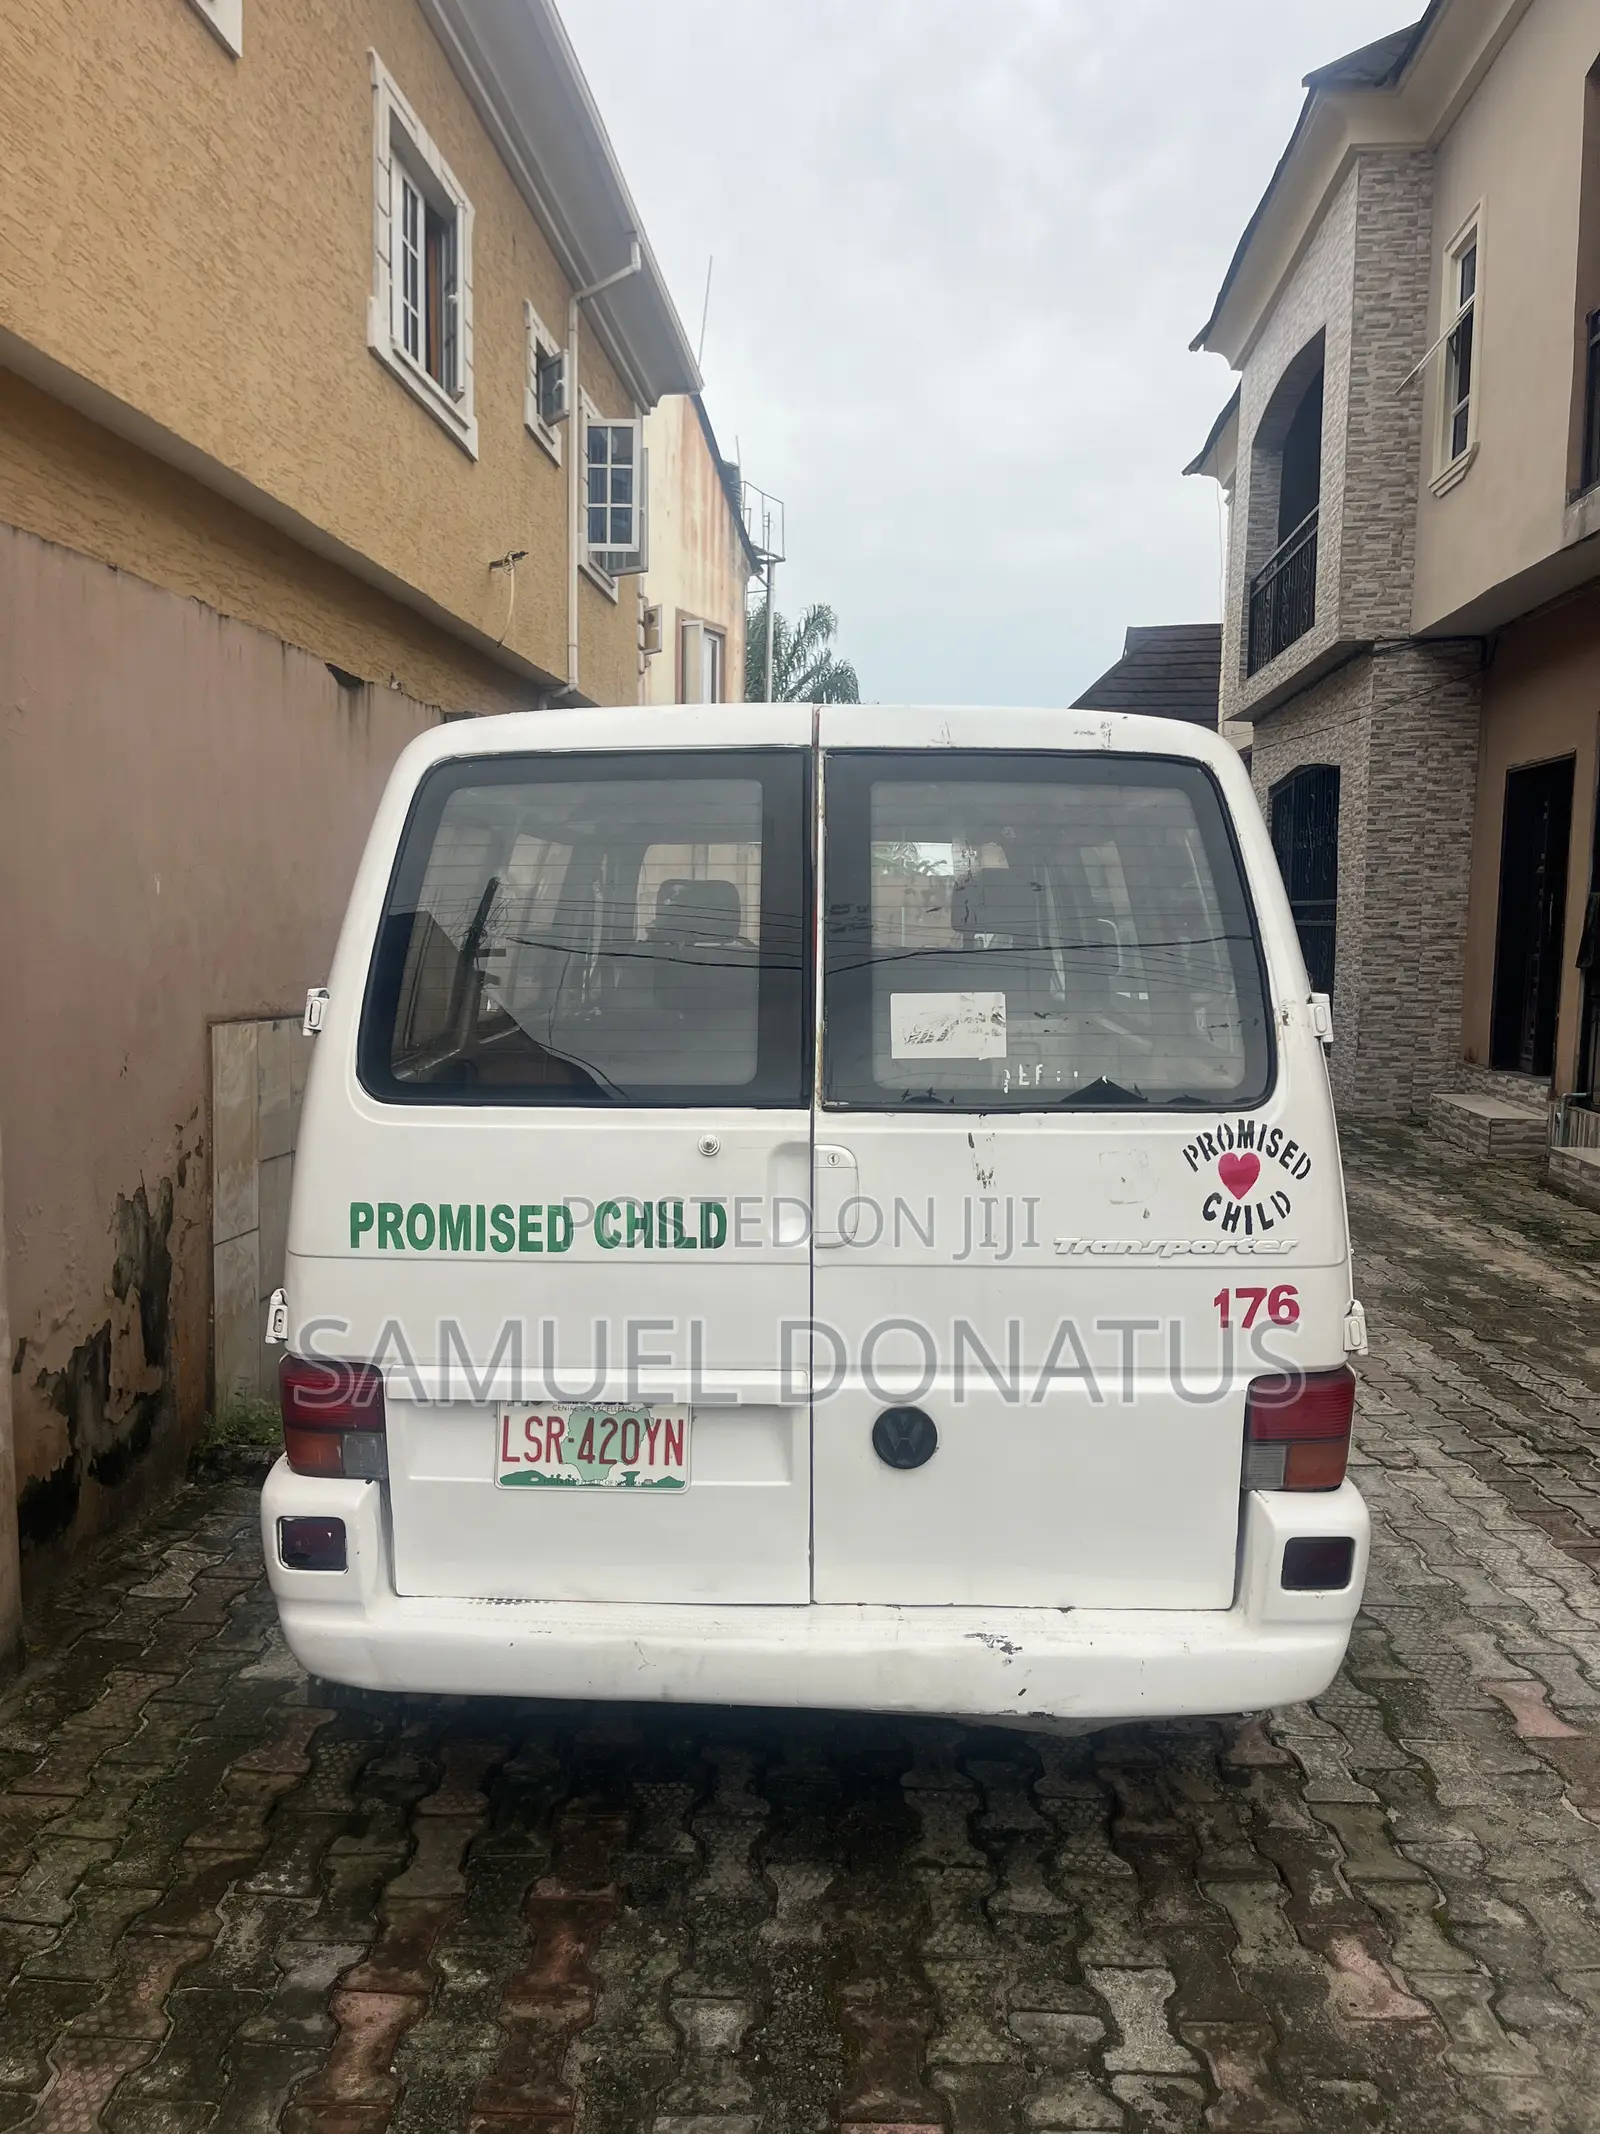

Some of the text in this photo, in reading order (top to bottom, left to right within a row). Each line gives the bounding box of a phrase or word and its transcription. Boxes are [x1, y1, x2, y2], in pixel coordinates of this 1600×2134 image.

[1182, 1119, 1312, 1180] PROMISED
[350, 1201, 727, 1253] PROMISED CHILD
[1202, 1192, 1291, 1235] CHILD
[1053, 1236, 1298, 1258] Transporter
[1213, 1284, 1300, 1329] 176
[502, 1415, 684, 1465] LSR-420YN
